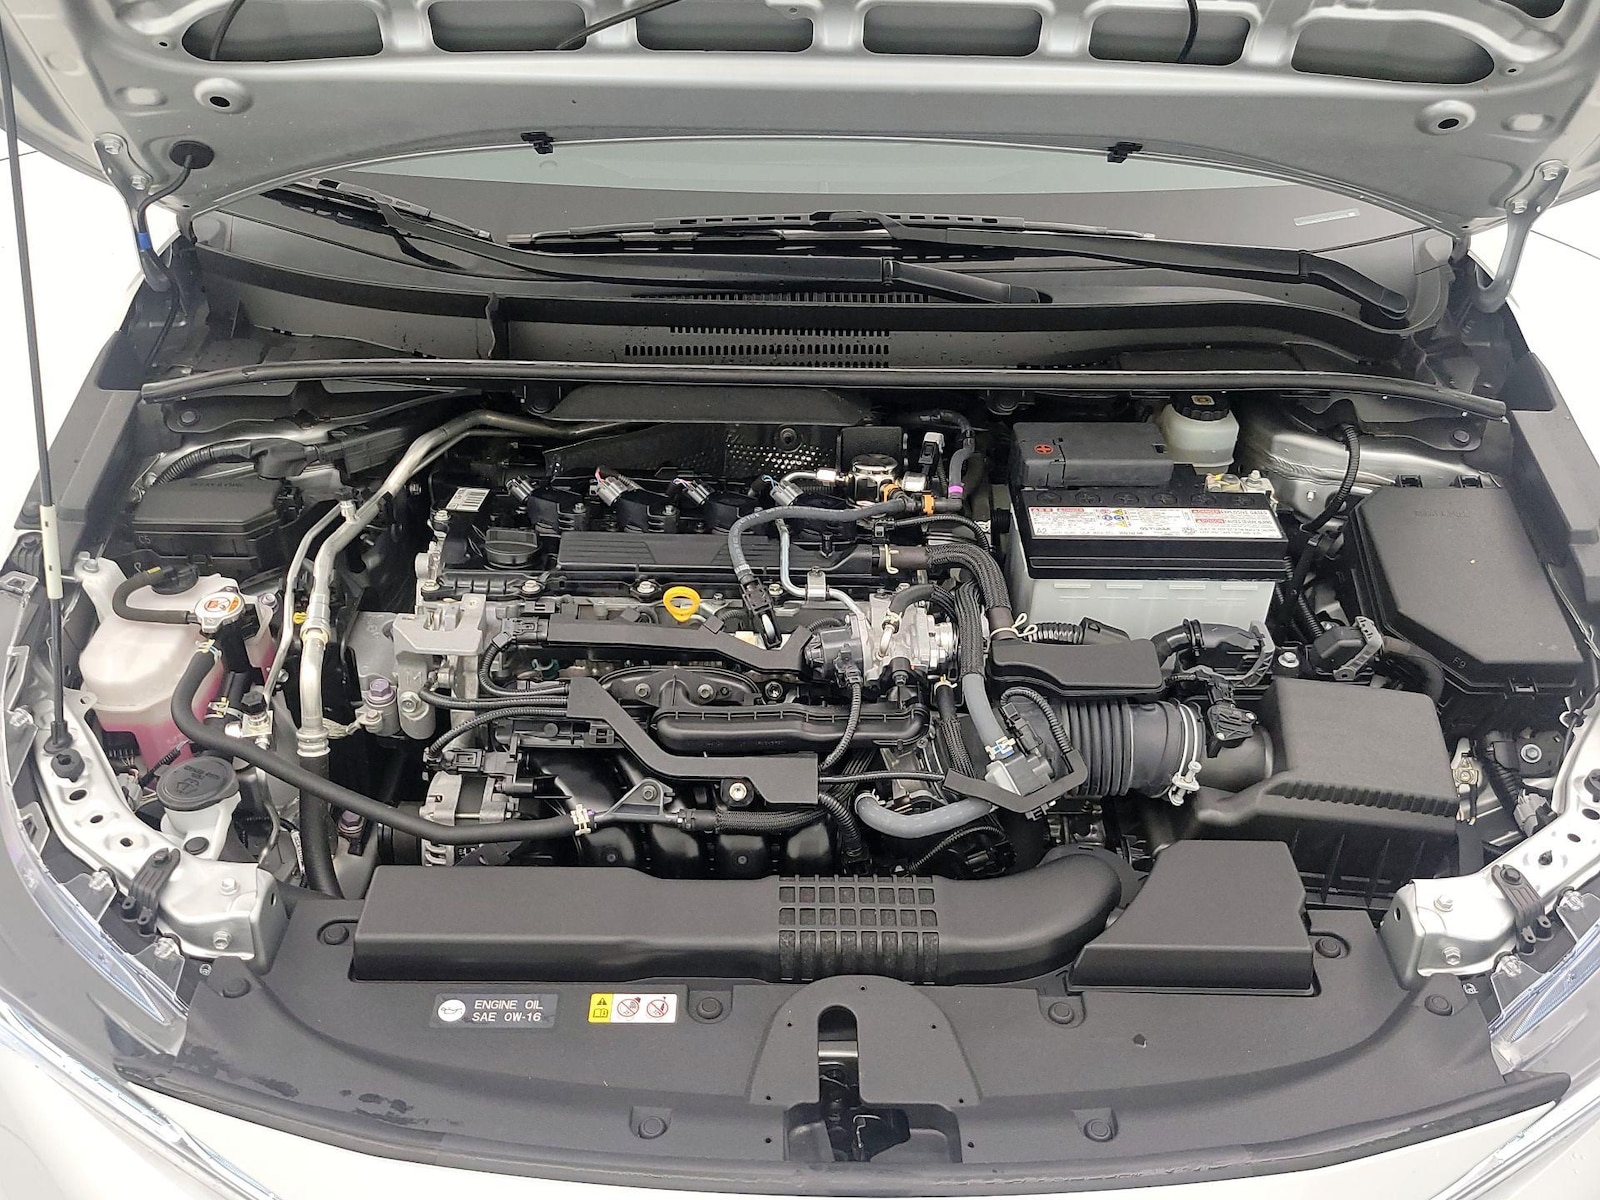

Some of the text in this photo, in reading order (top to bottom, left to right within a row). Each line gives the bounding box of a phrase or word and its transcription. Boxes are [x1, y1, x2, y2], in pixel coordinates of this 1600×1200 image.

[474, 1000, 543, 1010] ENGINE OIL
[472, 1012, 542, 1022] SAE 0W-16
